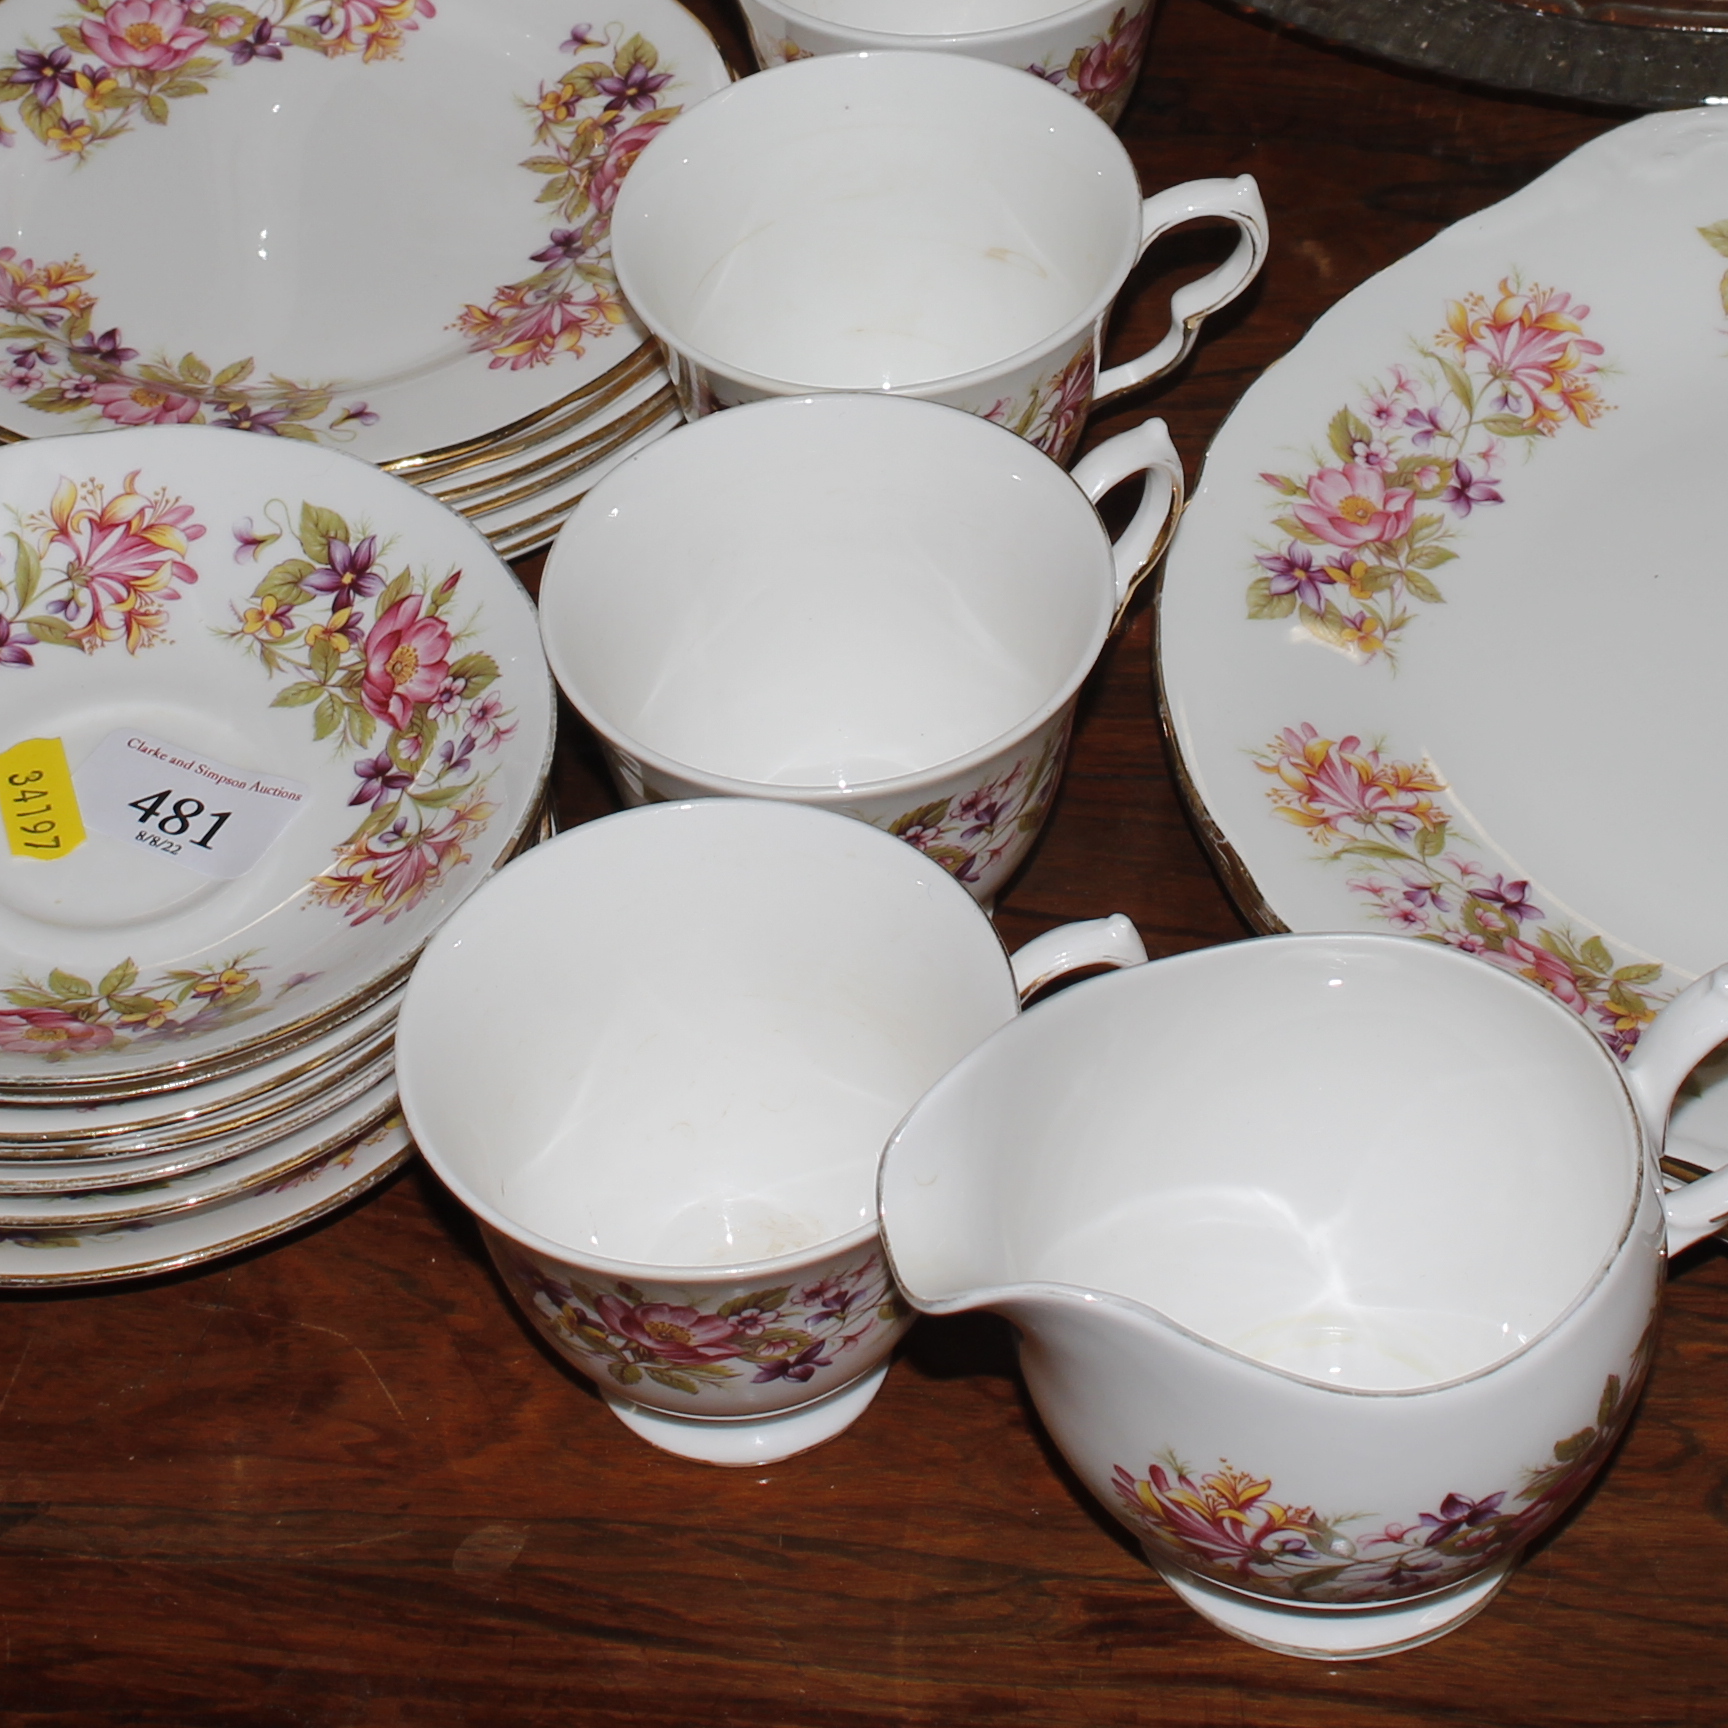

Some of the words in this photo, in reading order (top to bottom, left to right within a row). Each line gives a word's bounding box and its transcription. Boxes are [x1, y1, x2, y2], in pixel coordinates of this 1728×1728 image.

[126, 737, 169, 761] Clarke
[169, 755, 197, 771] and
[194, 763, 248, 790] Simpson
[248, 780, 303, 803] Auctions
[7, 769, 62, 850] 34197
[127, 788, 233, 851] 481
[134, 829, 183, 856] 8/8/22
